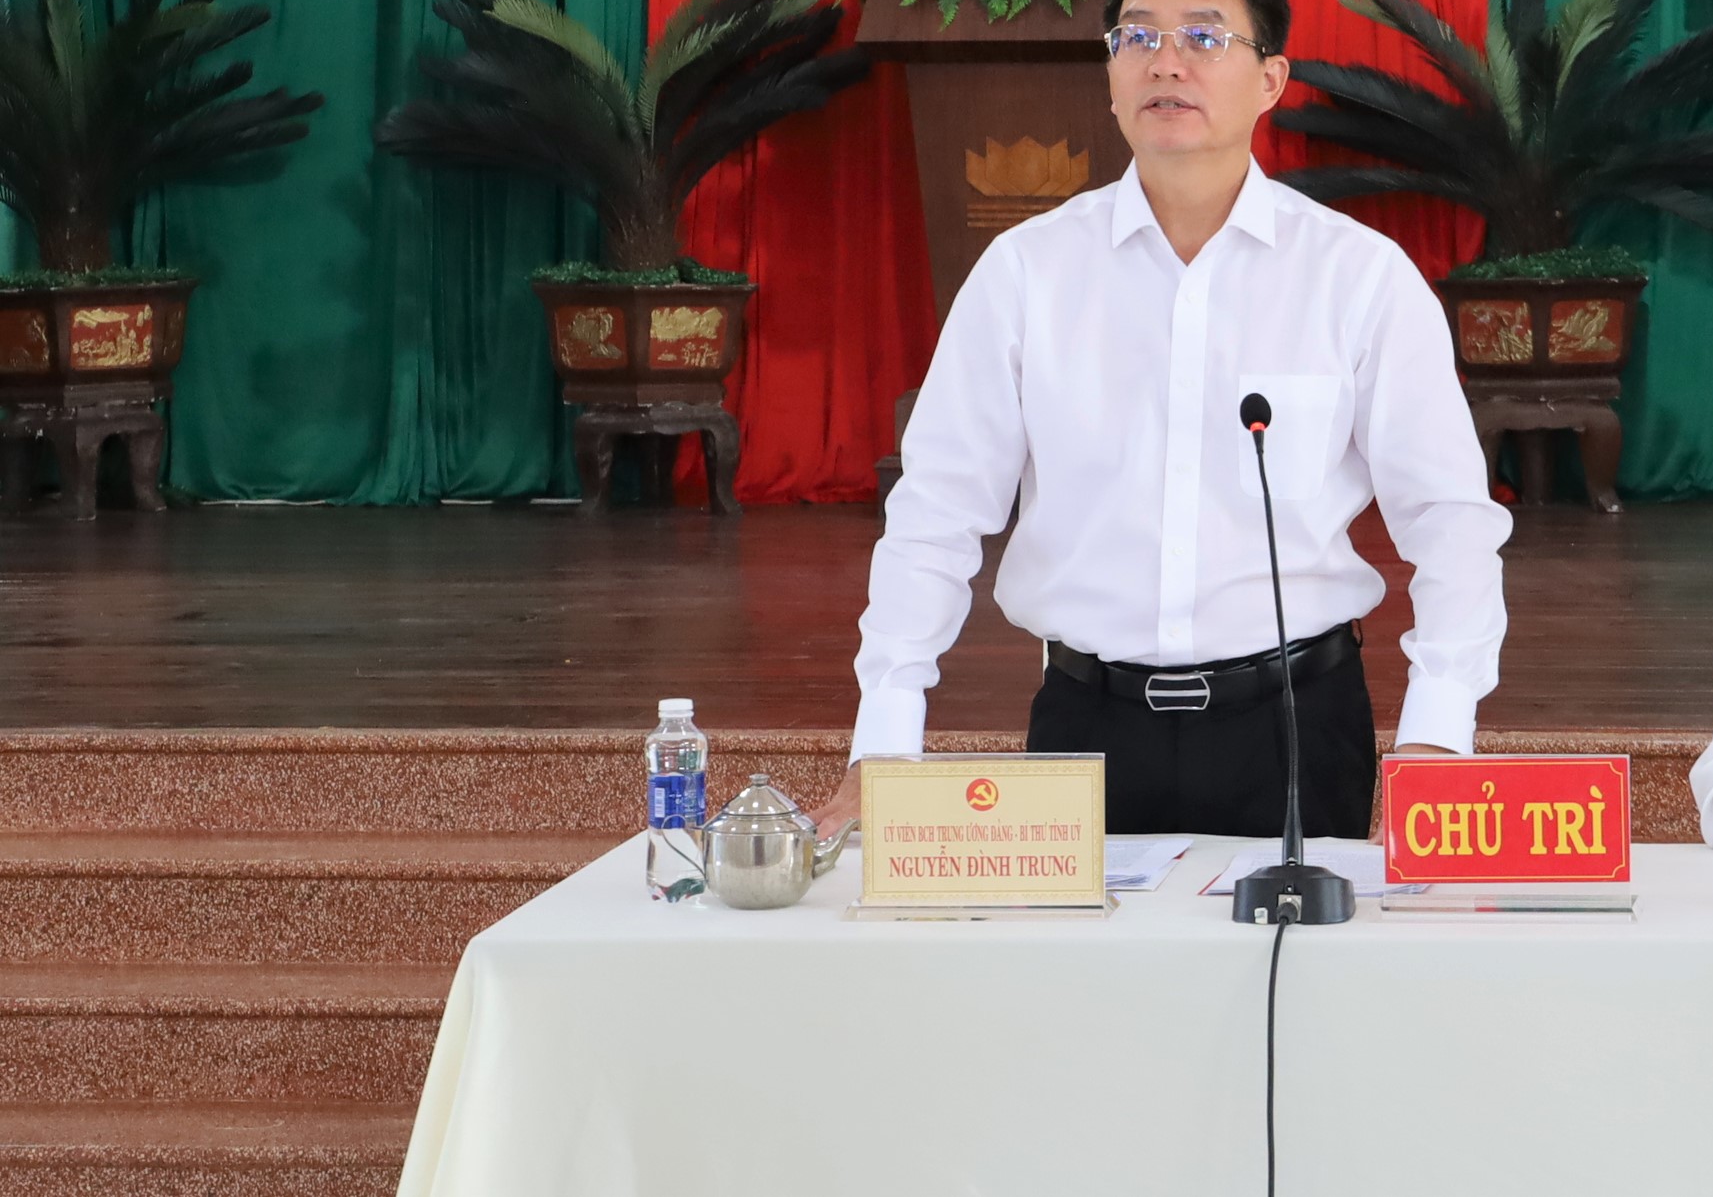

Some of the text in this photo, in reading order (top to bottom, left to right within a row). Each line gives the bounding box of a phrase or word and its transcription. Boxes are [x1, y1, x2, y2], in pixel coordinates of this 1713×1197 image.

[1405, 781, 1606, 856] CHỦ TRÌ
[889, 845, 1077, 877] NGUYỄN ĐÌNH TRUNG
